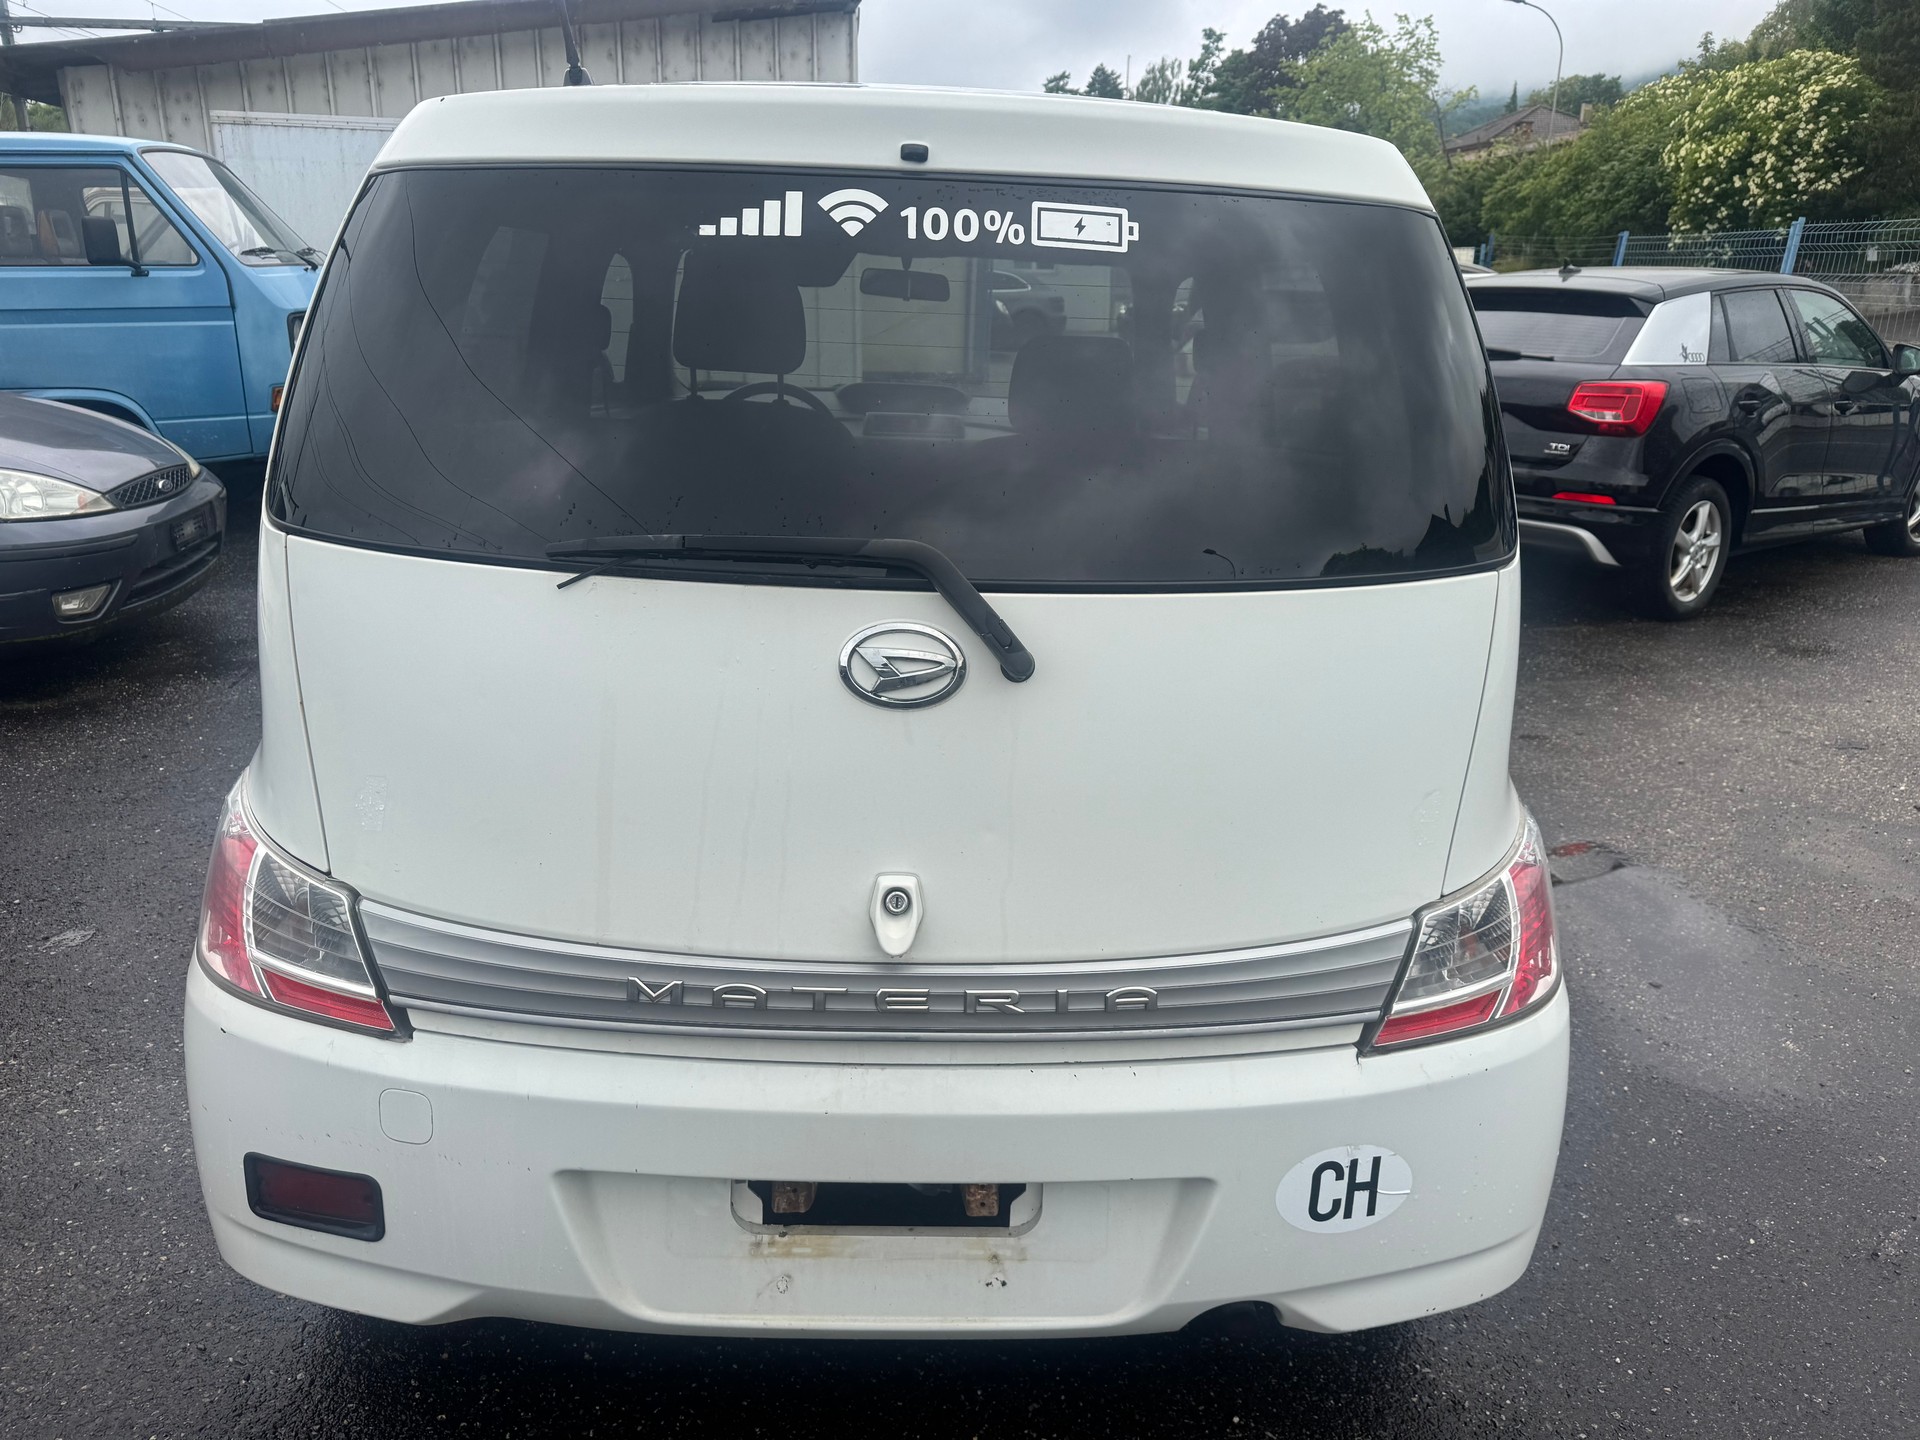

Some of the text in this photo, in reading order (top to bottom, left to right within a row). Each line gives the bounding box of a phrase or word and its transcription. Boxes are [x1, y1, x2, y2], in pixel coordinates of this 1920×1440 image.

[900, 206, 1025, 245] 100%
[1550, 442, 1571, 451] TDI
[626, 976, 1158, 1013] MATERIA
[1308, 1156, 1382, 1222] CH
